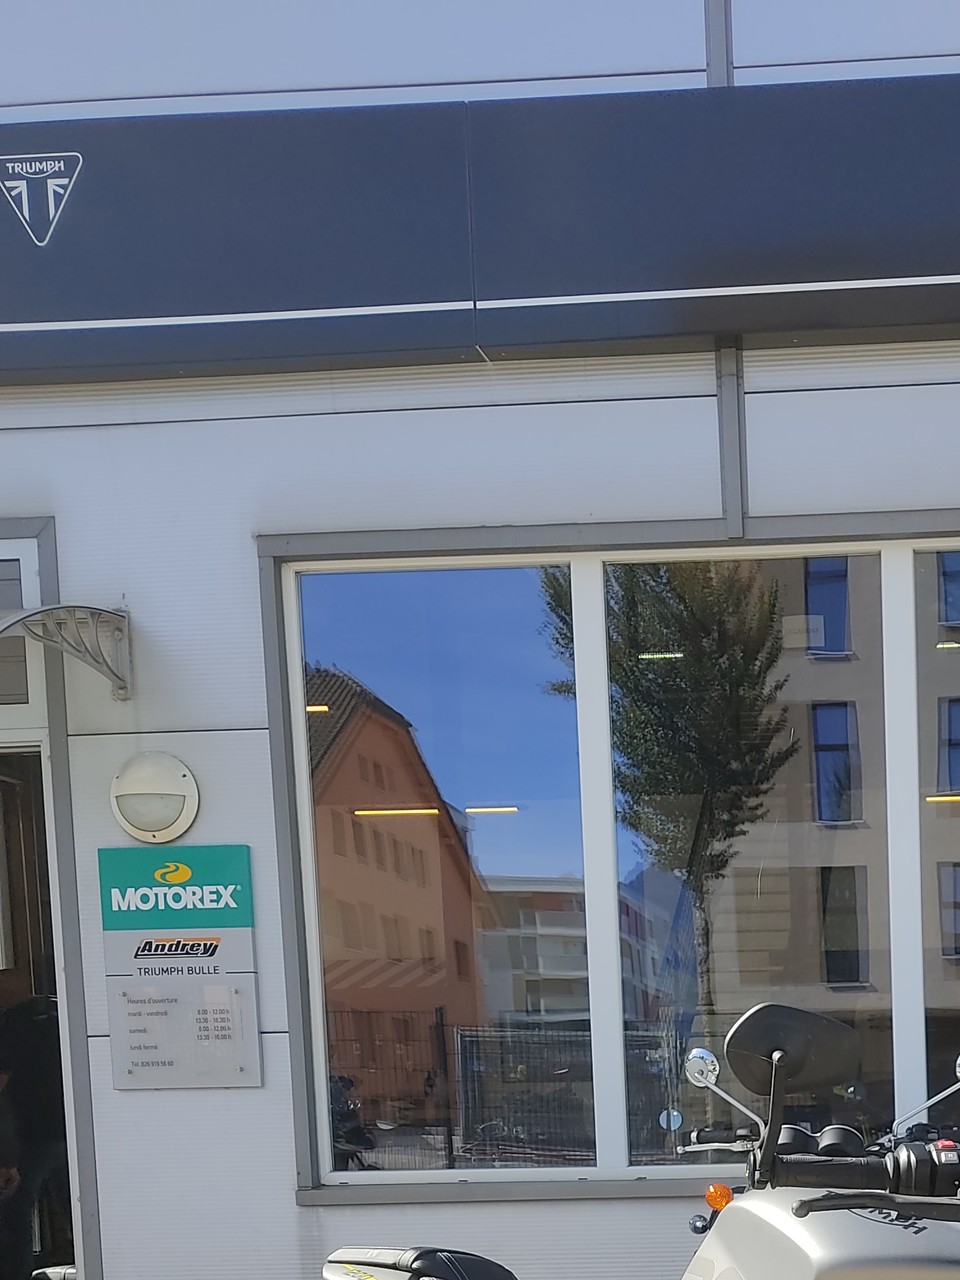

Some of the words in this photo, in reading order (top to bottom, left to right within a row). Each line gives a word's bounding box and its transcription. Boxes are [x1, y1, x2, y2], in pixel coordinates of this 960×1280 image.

[6, 160, 65, 177] TRIUMPH
[111, 885, 238, 911] MOTOREX
[140, 939, 215, 956] Andrey
[137, 966, 184, 977] TRIUMPH
[187, 965, 220, 976] BULLE
